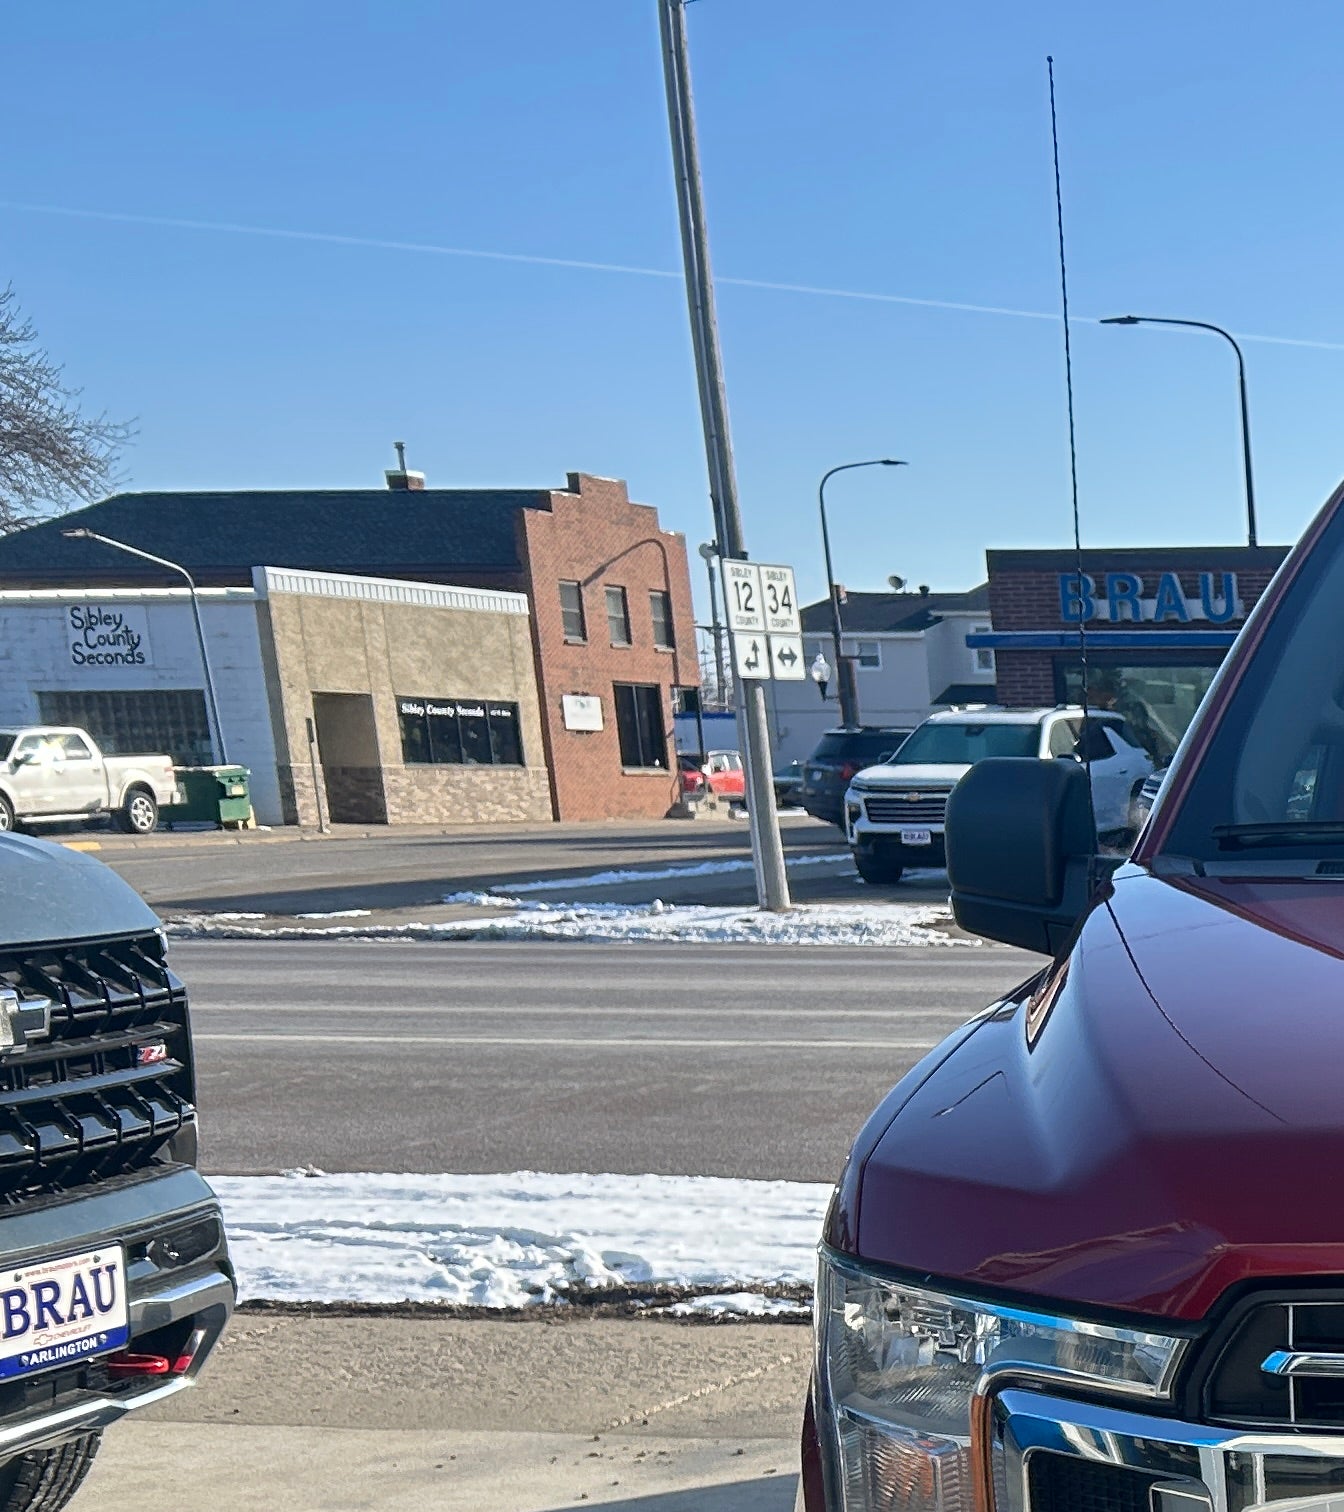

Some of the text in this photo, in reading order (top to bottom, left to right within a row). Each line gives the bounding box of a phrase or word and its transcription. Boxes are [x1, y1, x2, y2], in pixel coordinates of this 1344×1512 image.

[734, 581, 755, 612] 12
[767, 584, 792, 615] 34
[1058, 572, 1237, 624] BRAU
[70, 606, 122, 632] Sibley
[83, 625, 141, 651] County
[71, 642, 146, 665] Seconds
[0, 1264, 118, 1340] BRAU
[29, 1336, 98, 1366] ARLINGTON
